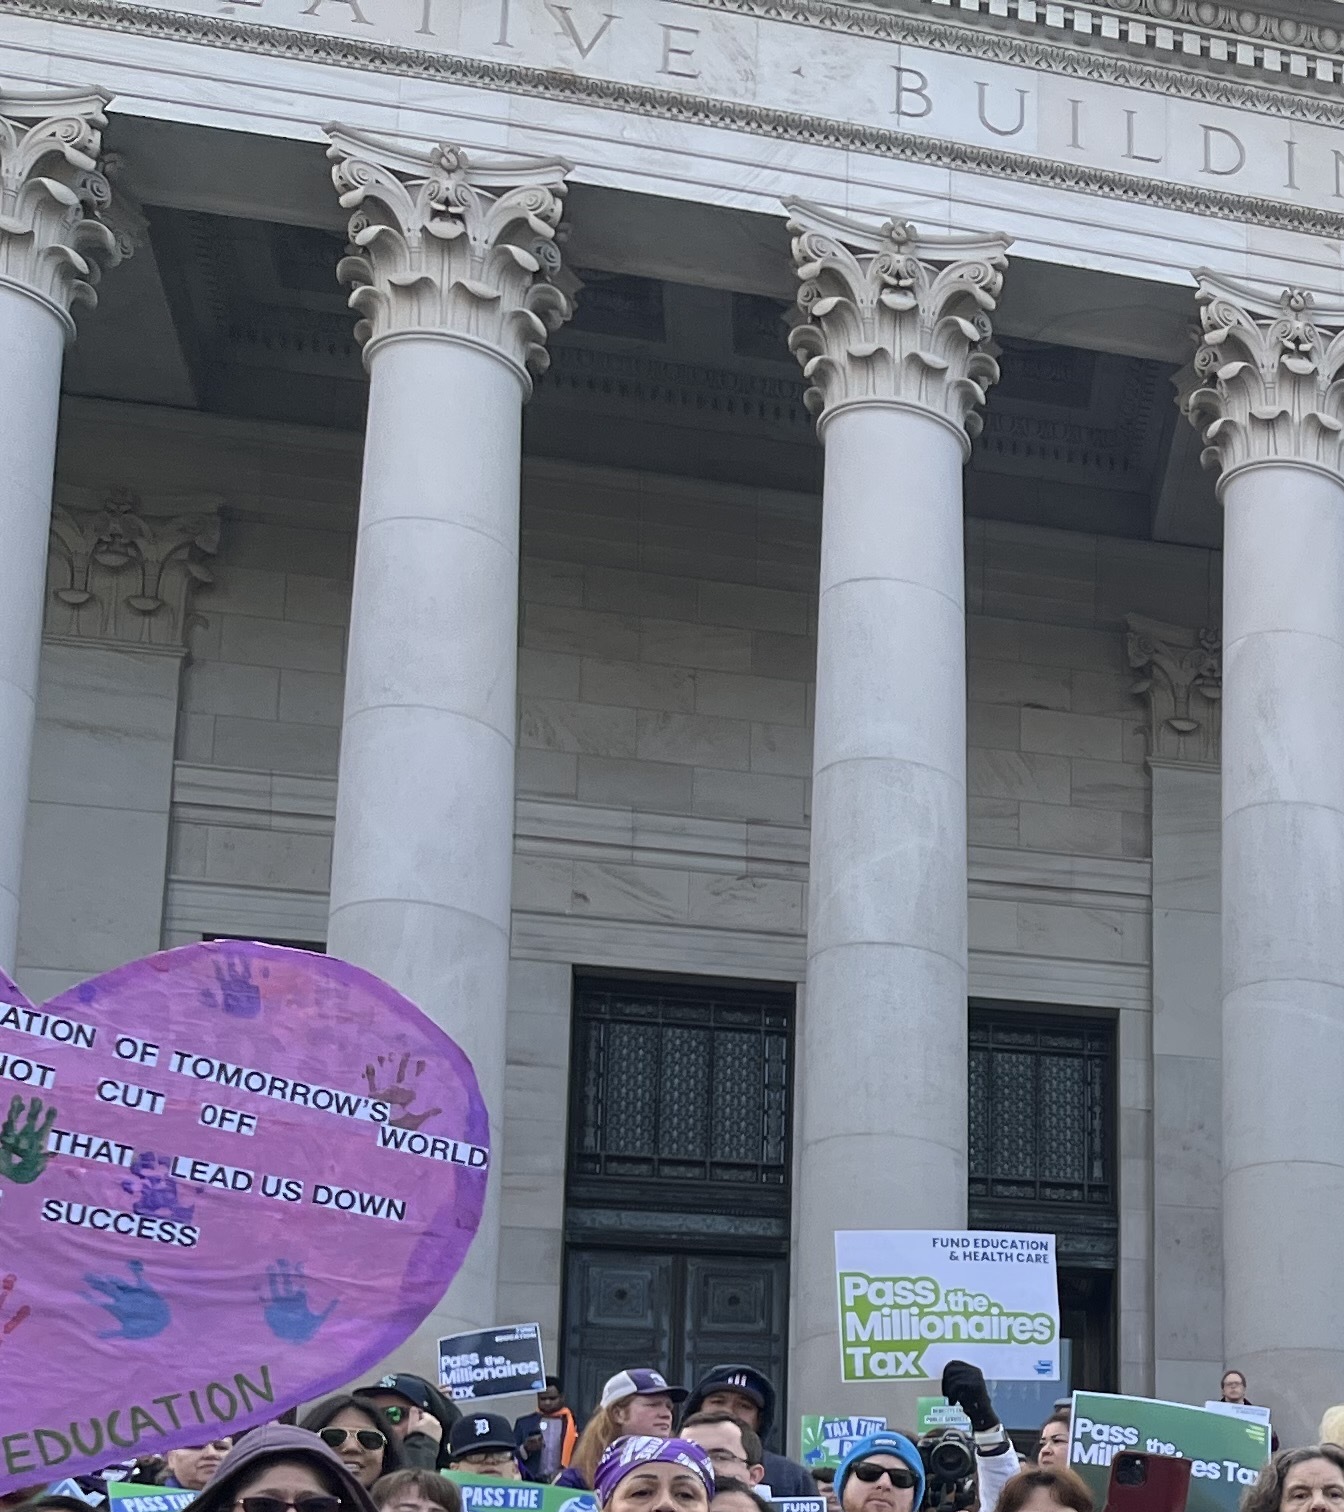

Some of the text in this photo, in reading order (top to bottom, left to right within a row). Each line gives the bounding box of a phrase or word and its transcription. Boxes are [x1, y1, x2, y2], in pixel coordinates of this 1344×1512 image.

[115, 1036, 158, 1066] OF
[97, 1080, 165, 1114] CUT
[381, 1126, 488, 1168] WORLD
[50, 1130, 405, 1222] THAT LEAD US DOWN
[42, 1201, 198, 1247] SUCCESS
[932, 1238, 1048, 1251] FUND EDUCATION
[949, 1251, 1049, 1264] & HEALTH CARE
[844, 1276, 989, 1313] Pass the
[846, 1306, 1051, 1342] Millionaires
[440, 1362, 539, 1386] Millionaires
[441, 1353, 505, 1368] Pass the
[846, 1347, 919, 1378] Tax
[3, 1365, 273, 1475] EDUCATION
[824, 1420, 884, 1438] TAX THE
[1074, 1418, 1175, 1458] Pass the
[462, 1487, 539, 1509] PASS THE
[783, 1502, 820, 1512] FUND
